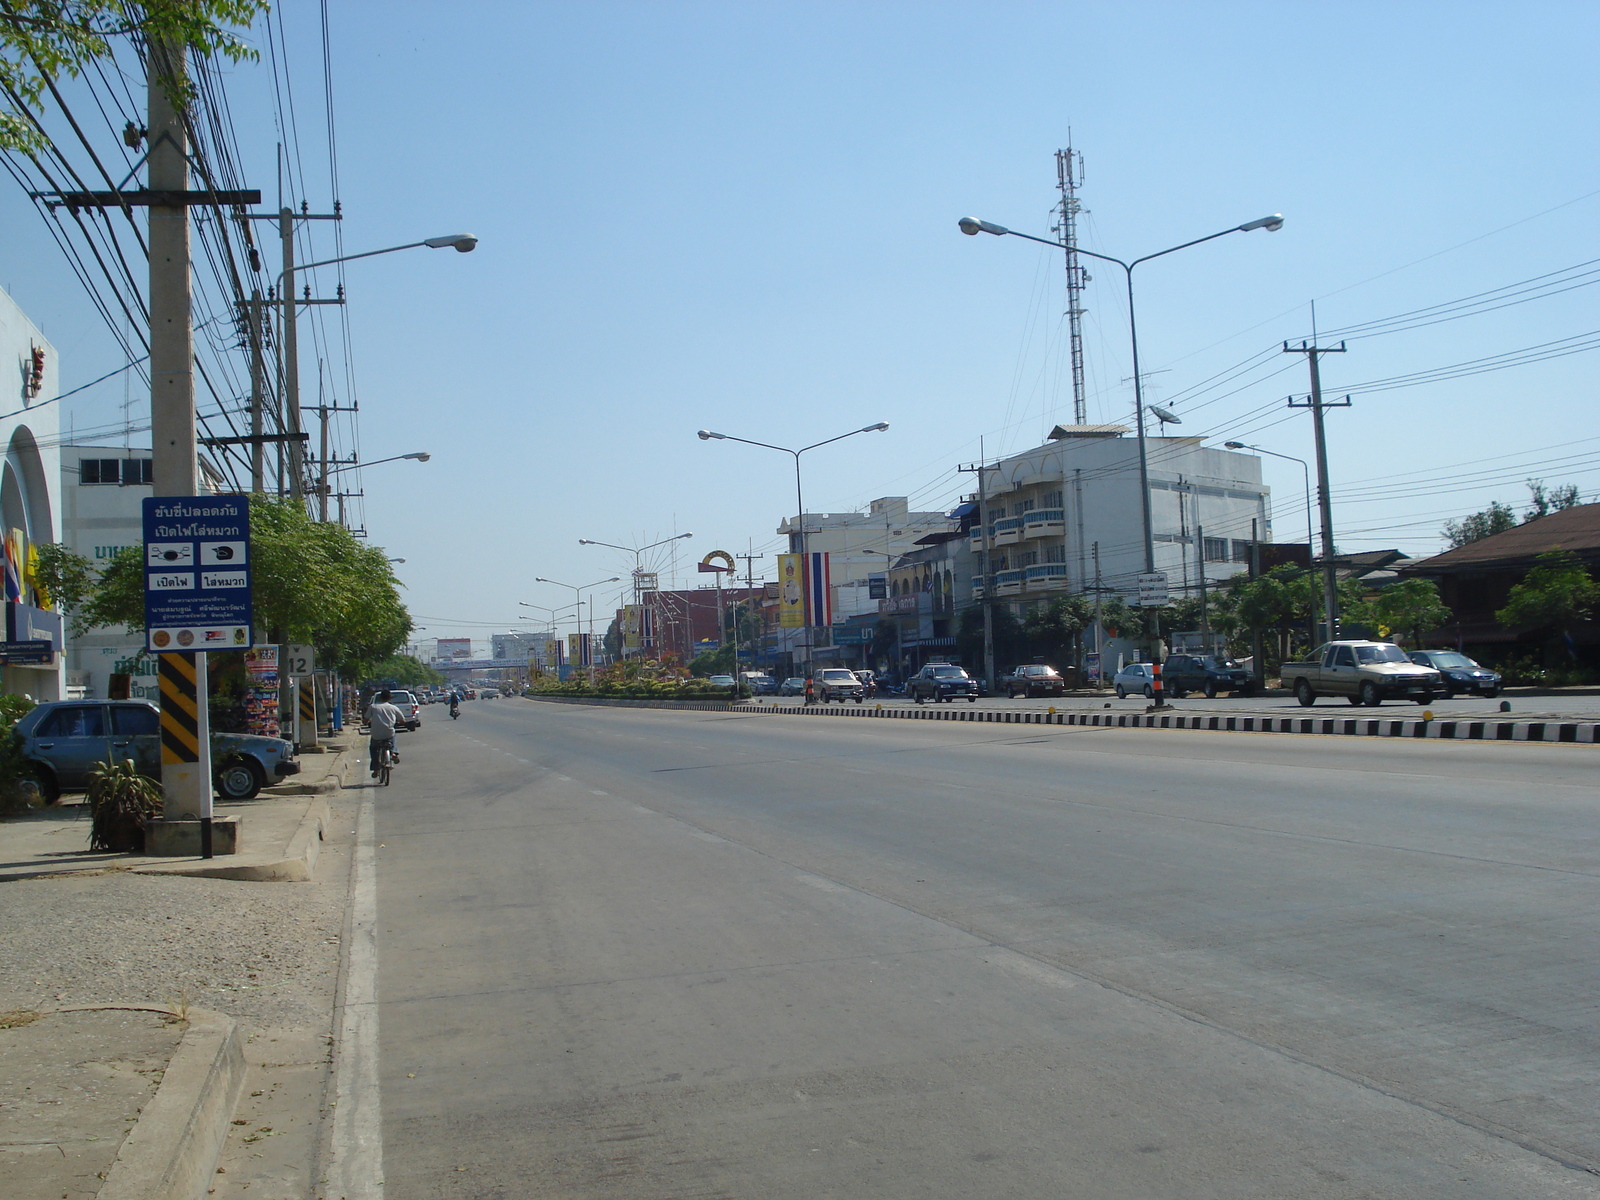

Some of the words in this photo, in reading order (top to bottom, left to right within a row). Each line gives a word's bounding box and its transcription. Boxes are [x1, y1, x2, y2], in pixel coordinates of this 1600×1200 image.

[154, 503, 238, 518] ขับขี่ปลอดภัย
[155, 523, 239, 538] เปิดไฟใส่หมวก
[156, 576, 188, 587] เปิดไฟ
[203, 573, 245, 587] ใส่หมวก
[289, 658, 306, 673] 12
